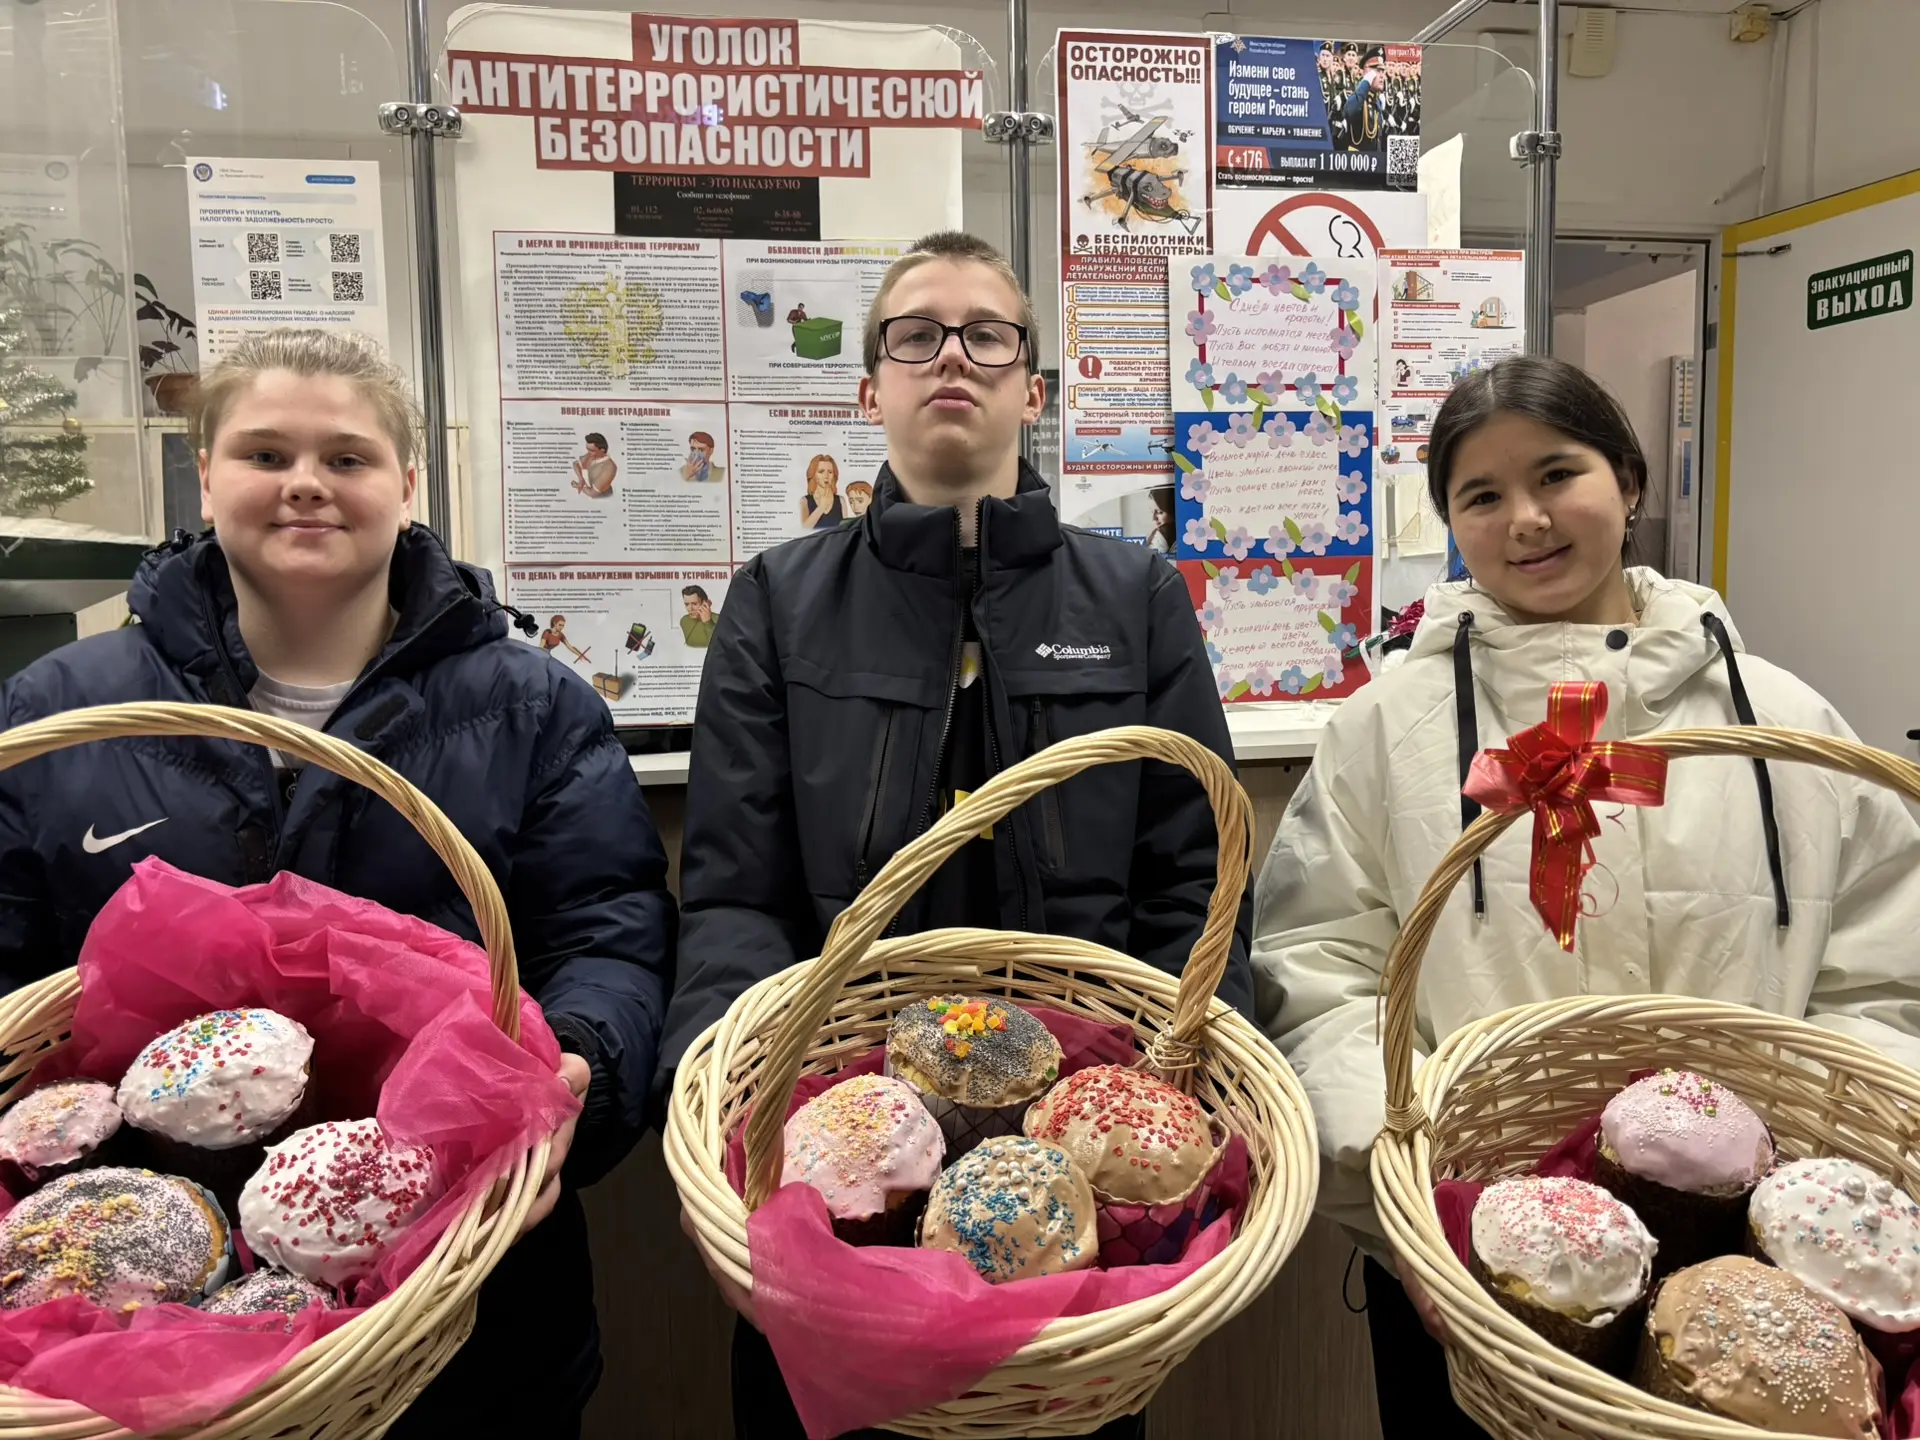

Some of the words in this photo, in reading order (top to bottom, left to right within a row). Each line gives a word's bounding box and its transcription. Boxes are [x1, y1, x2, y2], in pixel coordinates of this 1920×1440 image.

[649, 23, 793, 66] УГОЛОК
[1070, 46, 1201, 66] ОСТОРОЖНО
[1070, 65, 1201, 84] ОПАСНОСТЬ!!!
[1229, 60, 1270, 78] Измени
[1272, 67, 1296, 80] свое
[452, 59, 983, 119] АНТИТЕРРОРИСТИЧЕСКОЙ
[1228, 79, 1272, 100] будущее
[1281, 85, 1310, 99] стань
[1228, 100, 1266, 118] героем
[1268, 98, 1308, 117] России!
[1228, 124, 1255, 134] ОБУЧЕНИЕ
[1262, 126, 1286, 136] КАРЬЕРА
[1293, 128, 1322, 138] УВАЖЕНИЕ
[539, 117, 863, 169] БЕЗОПАСНОСТИ
[1280, 156, 1308, 168] ВЫПЛАТА
[1309, 158, 1316, 168] ОТ
[1320, 153, 1324, 170] 1
[1329, 153, 1348, 170] 100
[1350, 154, 1370, 170] 000
[1218, 172, 1234, 180] Стать
[630, 175, 696, 188] ТЕРРОРИЗМ
[710, 177, 730, 188] ЭТО
[732, 178, 801, 190] НАКАЗУЕМО
[526, 240, 554, 248] МЕРАХ
[650, 241, 700, 251] ТЕРРОРИЗМУ
[1094, 234, 1204, 246] БЕСПИЛОТНИКИ
[768, 246, 821, 255] ОБЯЗАННОСТИ
[1094, 245, 1204, 256] КВАДРОКОПТЕРЫ
[1081, 256, 1122, 264] ПРАВИЛА
[1070, 264, 1136, 272] ОБНАРУЖЕНИИ
[1066, 272, 1132, 280] ЛЕТАТЕЛЬНОГО
[1811, 255, 1910, 294] ЭВАКУАЦИОННЫЙ
[1816, 280, 1904, 320] ВЫХОД
[1274, 303, 1308, 312] цветов
[1216, 324, 1241, 336] Пусть
[1208, 340, 1234, 351] Пусть
[1222, 360, 1256, 368] теплом
[561, 407, 605, 416] ПОВЕДЕНИЕ
[608, 408, 670, 417] ПОСТРАДАВШИХ
[792, 410, 806, 418] ВАС
[809, 410, 852, 418] ЗАХВАТИЛИ
[1209, 486, 1232, 495] Пусть
[1209, 505, 1232, 514] Пусть
[512, 572, 525, 580] ЧТО
[528, 572, 556, 580] ДЕЛАТЬ
[559, 572, 574, 580] ПРИ
[577, 572, 632, 580] ОБНАРУЖЕНИИ
[635, 572, 680, 580] ВЗРЫВНОГО
[682, 571, 728, 580] УСТРОЙСТВА
[1223, 600, 1246, 611] Пусть
[1250, 598, 1296, 608] улыбается
[1052, 644, 1111, 656] Columbia
